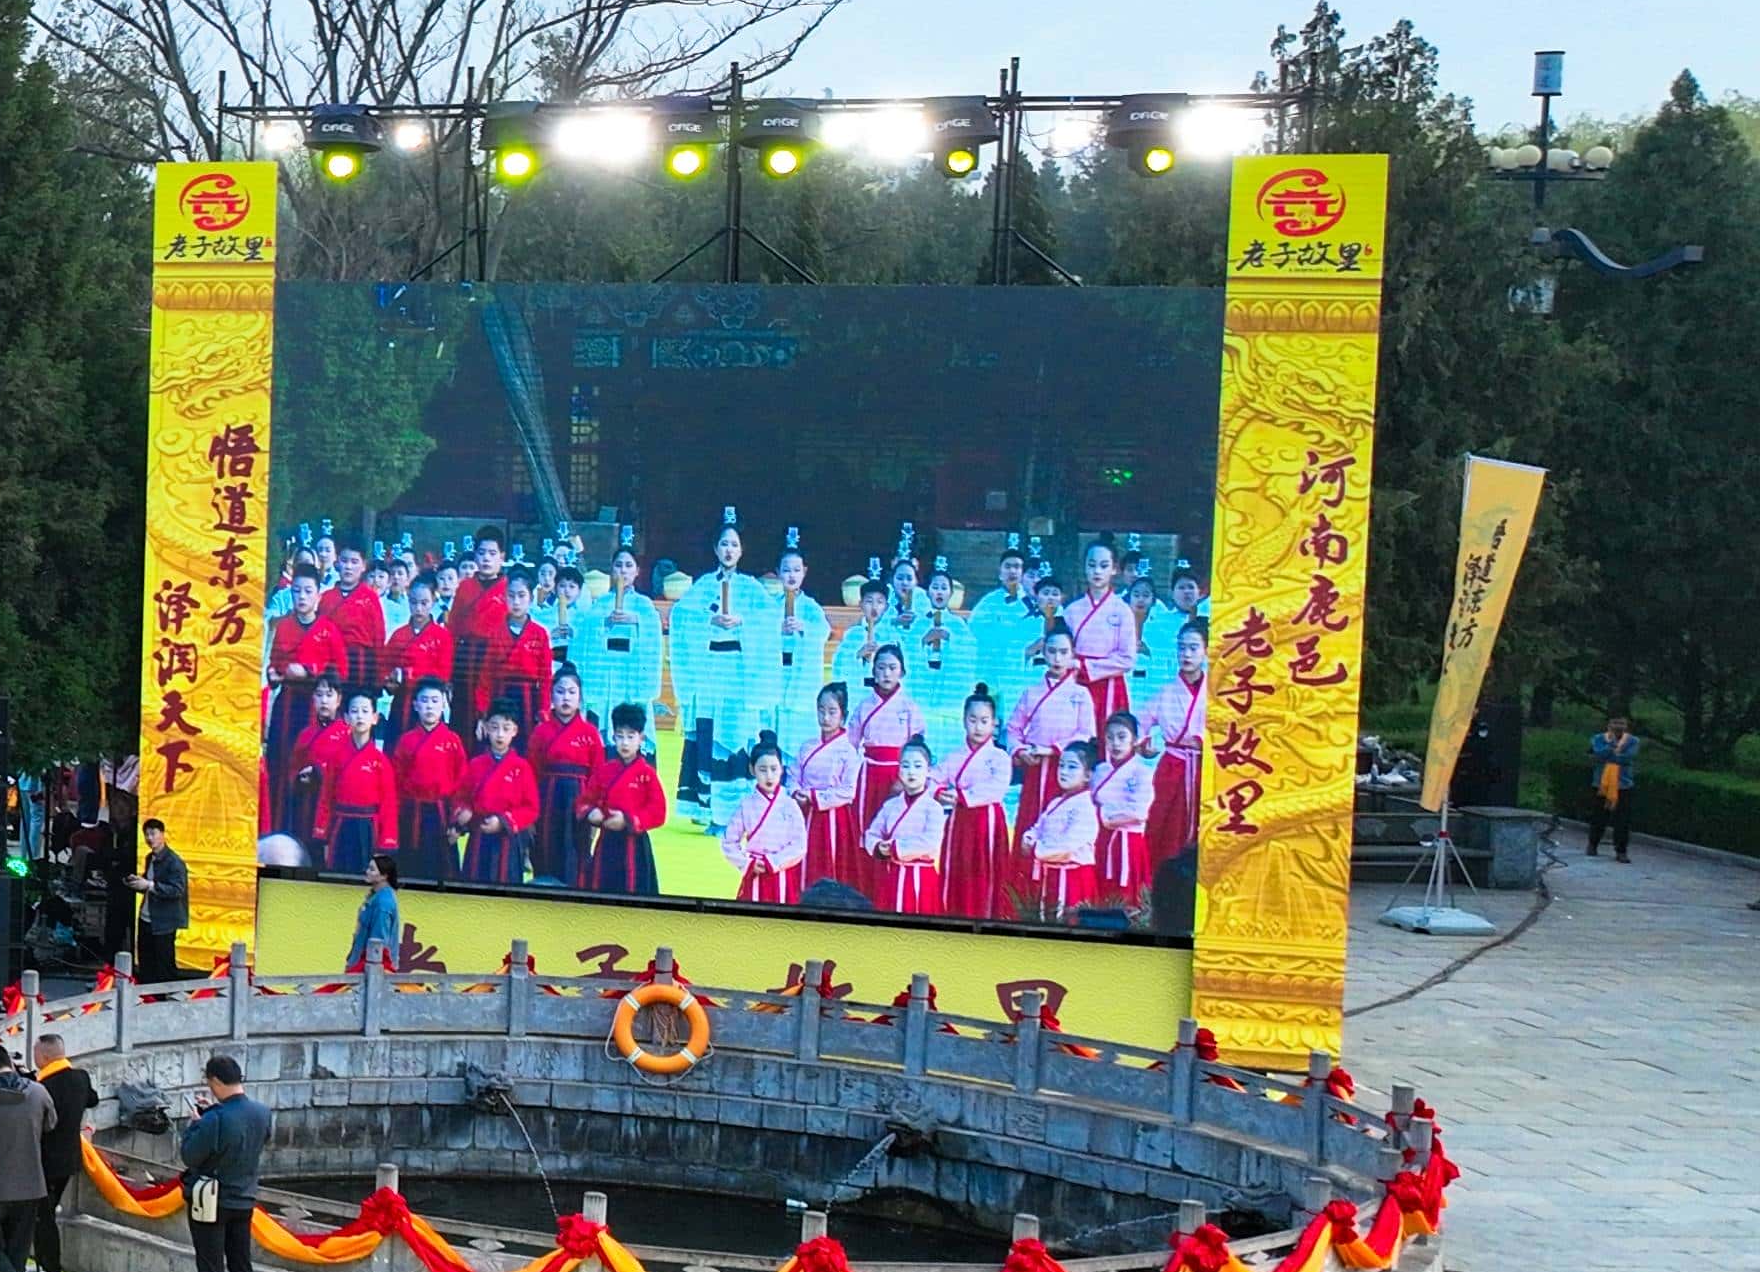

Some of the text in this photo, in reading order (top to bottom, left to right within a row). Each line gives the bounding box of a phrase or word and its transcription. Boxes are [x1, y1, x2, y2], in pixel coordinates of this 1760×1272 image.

[164, 234, 263, 262] 老子故里
[1236, 239, 1361, 272] 老子故里
[208, 424, 260, 646] 悟道东方
[1288, 451, 1356, 687] 河南鹿邑
[153, 580, 202, 794] 泽润天下
[1212, 607, 1275, 835] 老子故里
